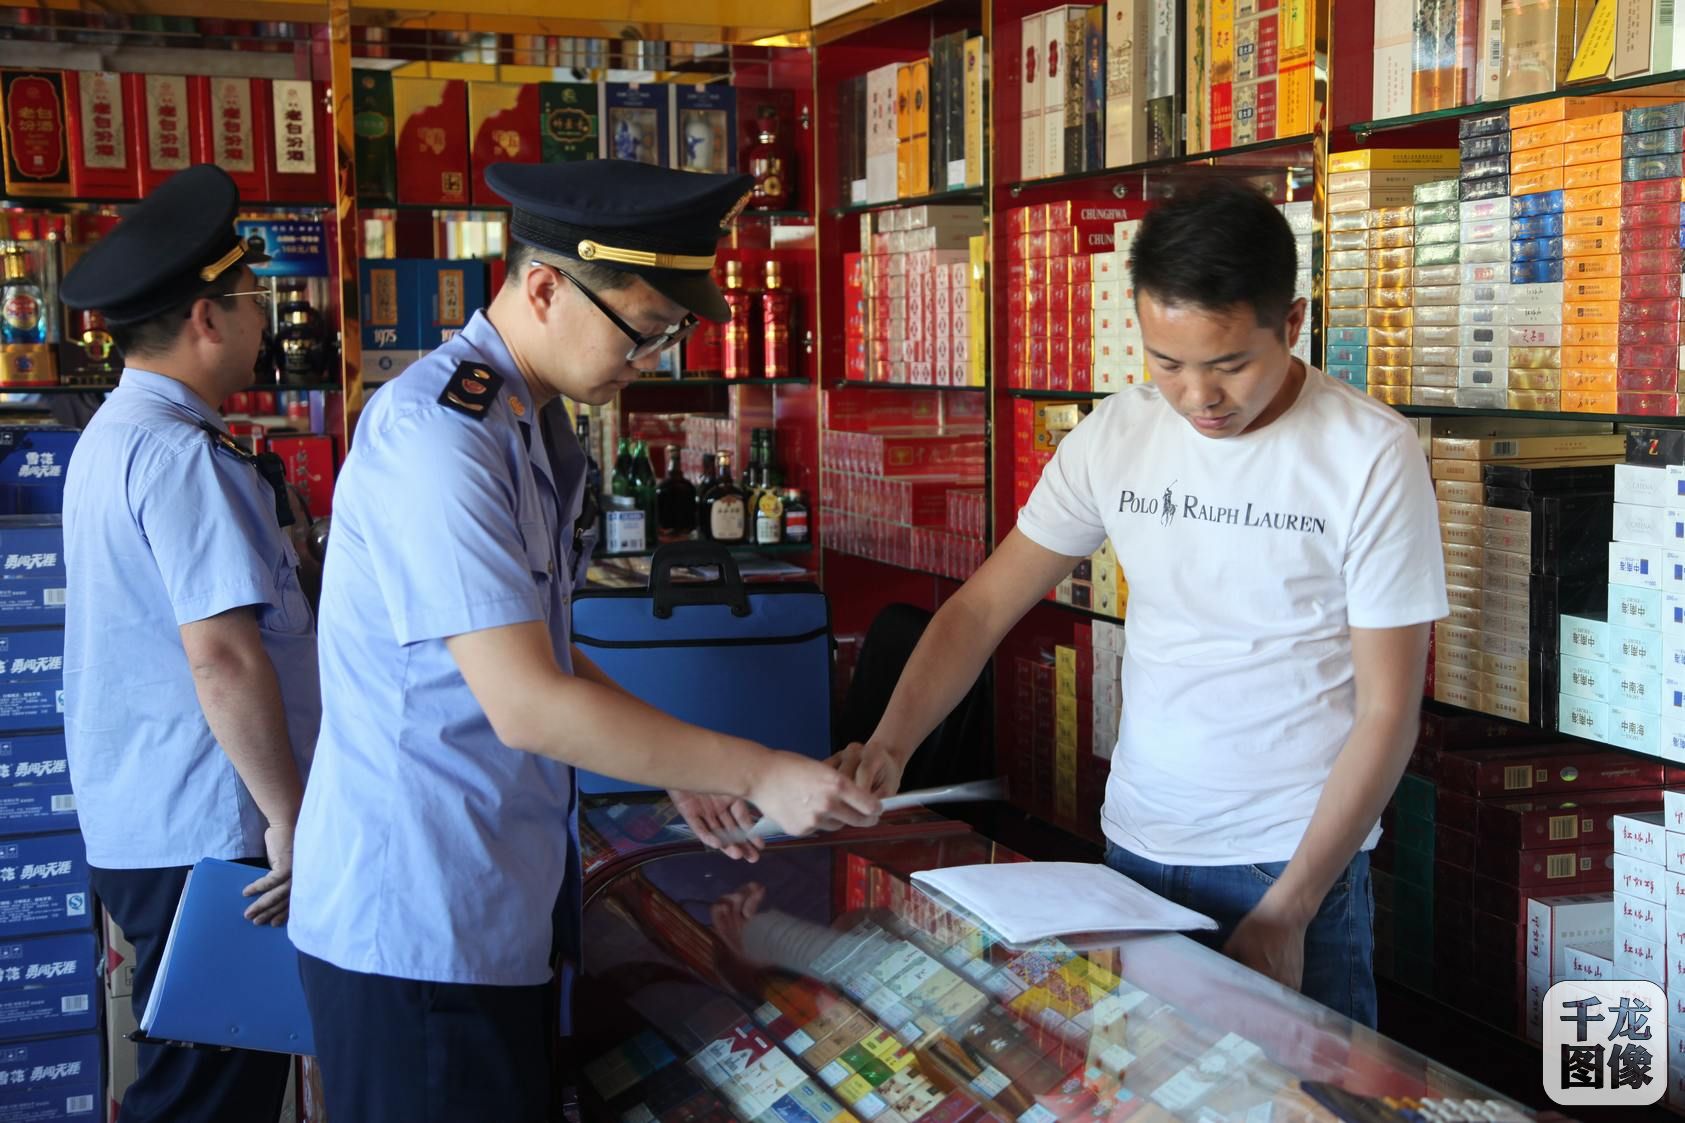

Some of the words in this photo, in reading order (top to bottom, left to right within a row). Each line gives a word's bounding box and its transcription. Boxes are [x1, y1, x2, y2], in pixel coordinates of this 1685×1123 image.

[285, 110, 304, 161] 老白汾酒
[1081, 208, 1128, 221] CHUNGHWA
[374, 329, 397, 348] 1975
[4, 553, 57, 569] 勇闯天涯
[10, 656, 62, 674] 勇闯天涯
[1621, 680, 1645, 695] 中南海
[1621, 720, 1645, 736] 中南海
[15, 759, 67, 778] 勇闯天涯
[1623, 825, 1653, 845] 红塔山
[20, 860, 72, 880] 勇闯天涯
[1623, 902, 1653, 923] 红塔山
[1623, 938, 1653, 960] 红塔山
[25, 960, 77, 980] 勇闯天涯
[1573, 957, 1602, 978] 红塔山
[30, 1061, 82, 1082] 勇闯天涯
